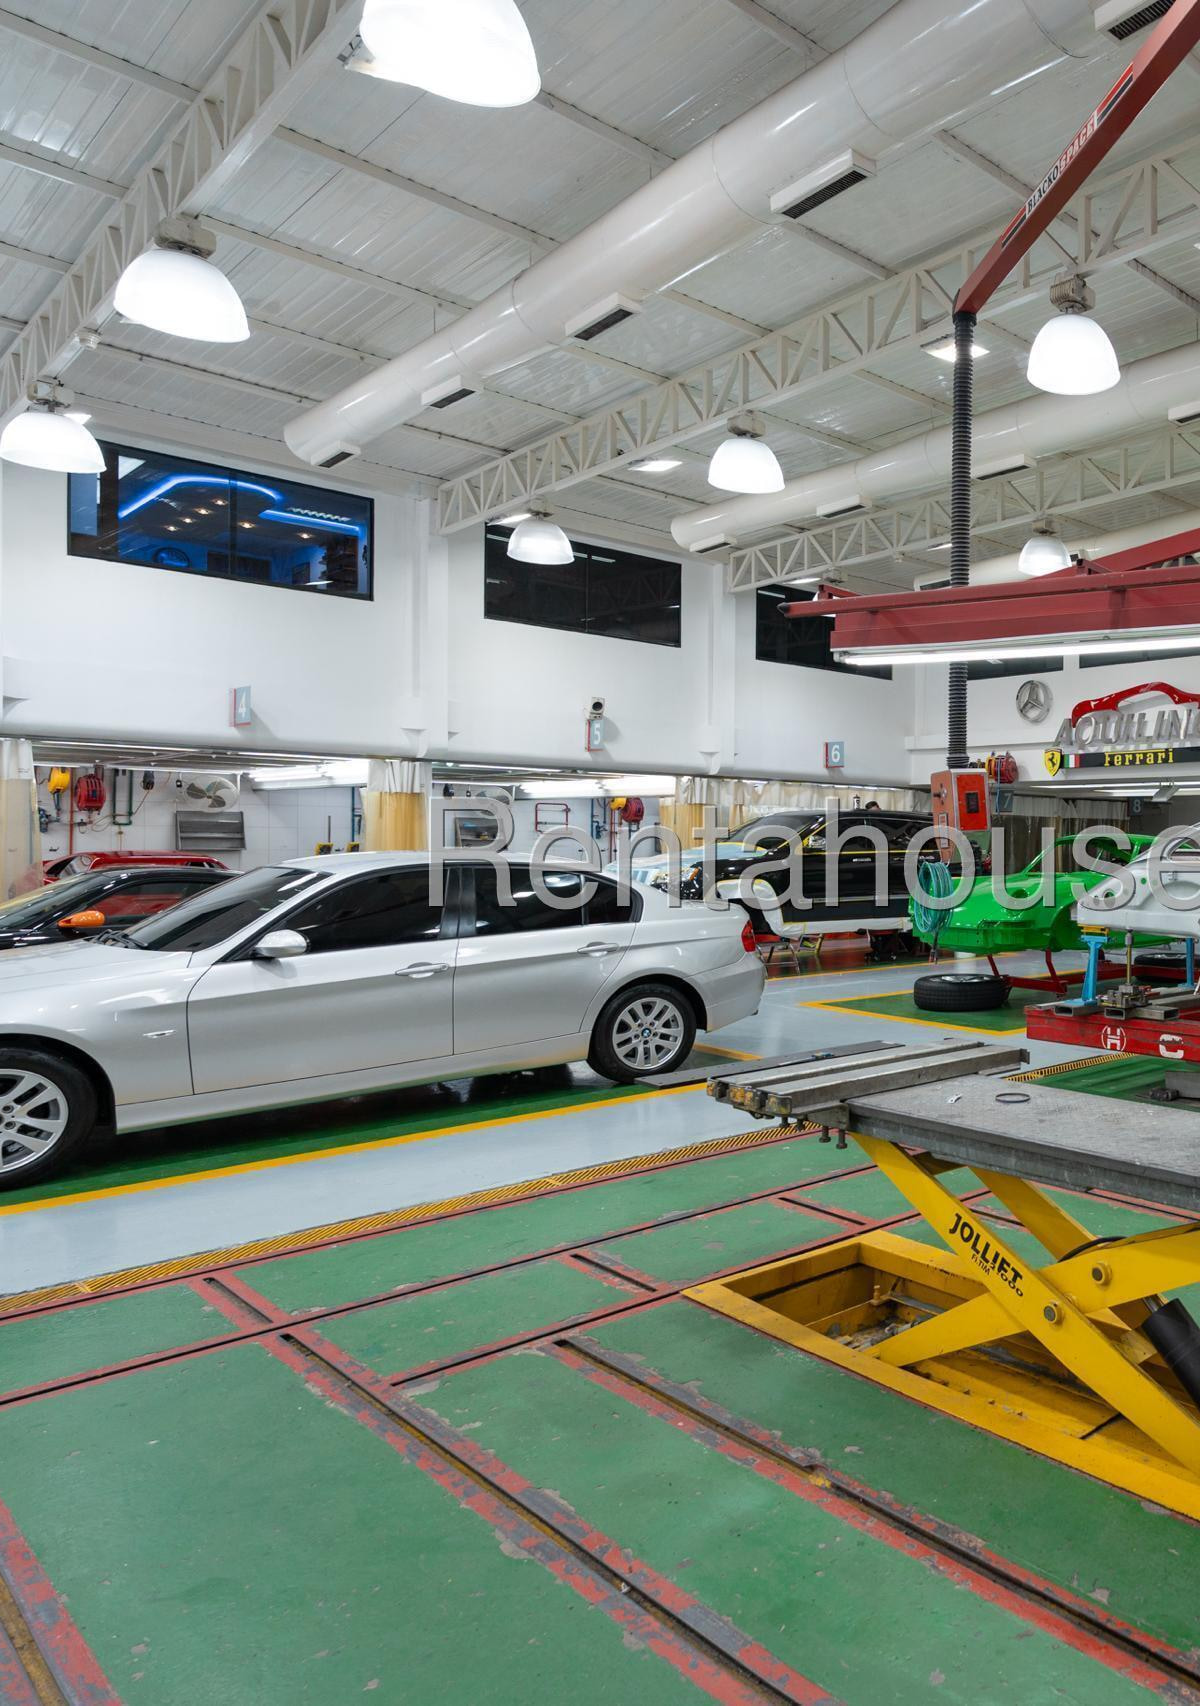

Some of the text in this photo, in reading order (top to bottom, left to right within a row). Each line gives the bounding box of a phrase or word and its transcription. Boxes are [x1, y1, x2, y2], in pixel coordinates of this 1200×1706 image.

[237, 692, 248, 718] 4
[593, 722, 602, 745] 5
[830, 744, 840, 763] 6
[1104, 749, 1174, 767] Ferrari
[1003, 792, 1012, 809] 7
